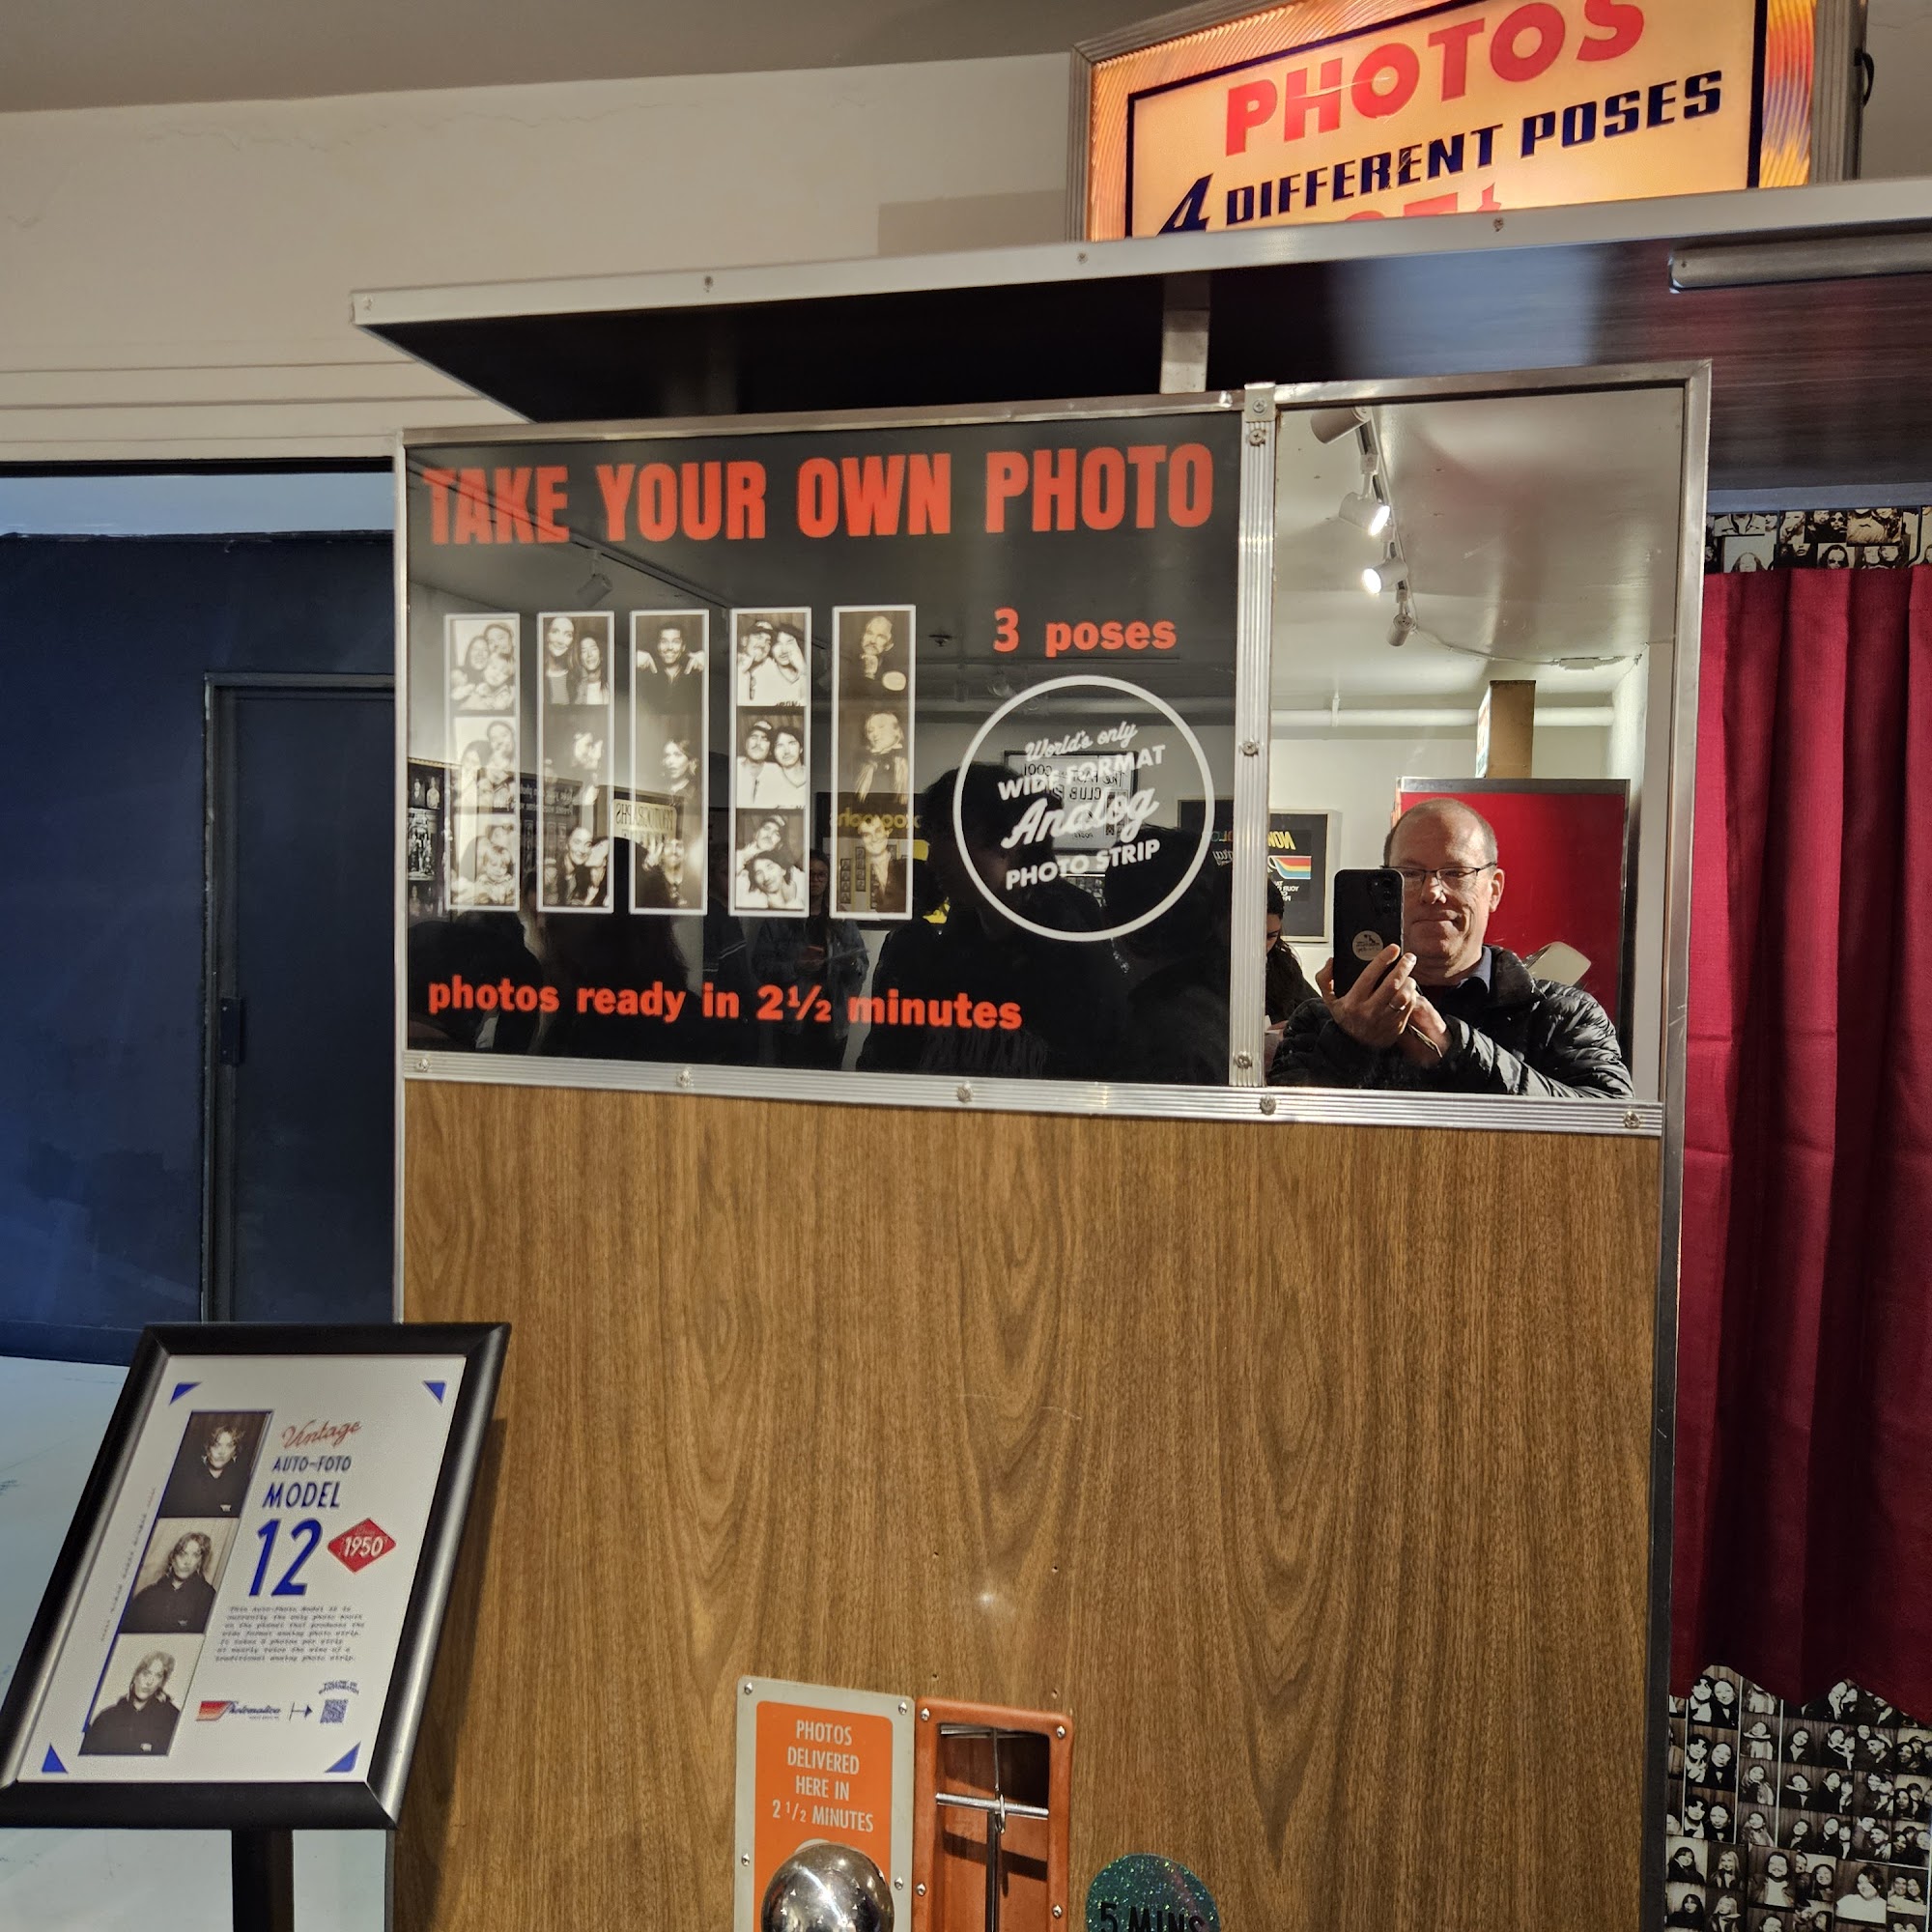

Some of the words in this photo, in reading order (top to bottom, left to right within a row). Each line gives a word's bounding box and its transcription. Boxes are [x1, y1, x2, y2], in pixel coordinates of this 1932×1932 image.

[1225, 0, 1644, 156] PHOTOS
[1156, 173, 1213, 237] 4
[1227, 125, 1504, 226] DIFFERENT
[1521, 70, 1721, 158] POSES
[422, 465, 570, 545] TAKE
[596, 460, 767, 542] YOUR
[797, 453, 952, 538] OWN
[984, 443, 1213, 533] PHOTO
[993, 607, 1020, 653] 3
[1045, 619, 1177, 658] poses
[1025, 730, 1093, 761] World's
[1097, 721, 1138, 749] only
[998, 770, 1061, 801] WIDE
[1066, 745, 1166, 785] FORMAT
[1001, 787, 1159, 849] Analog
[1006, 855, 1092, 890] PHOTO
[1096, 838, 1160, 872] STRIP
[428, 975, 559, 1015] photos
[577, 981, 685, 1023] ready
[702, 982, 739, 1019] in
[847, 987, 1022, 1031] minutes
[282, 1419, 363, 1449] Vintage
[271, 1455, 352, 1472] AUTO-FOTO
[262, 1481, 342, 1508] MODEL
[248, 1518, 323, 1597] 12
[344, 1536, 384, 1557] 1950
[795, 1719, 853, 1747] PHOTOS
[786, 1746, 860, 1776] DELIVERED
[795, 1775, 829, 1799] HERE
[835, 1780, 850, 1802] IN
[772, 1799, 781, 1820] 2
[811, 1804, 874, 1833] MINUTES
[1100, 1901, 1119, 1932] 5
